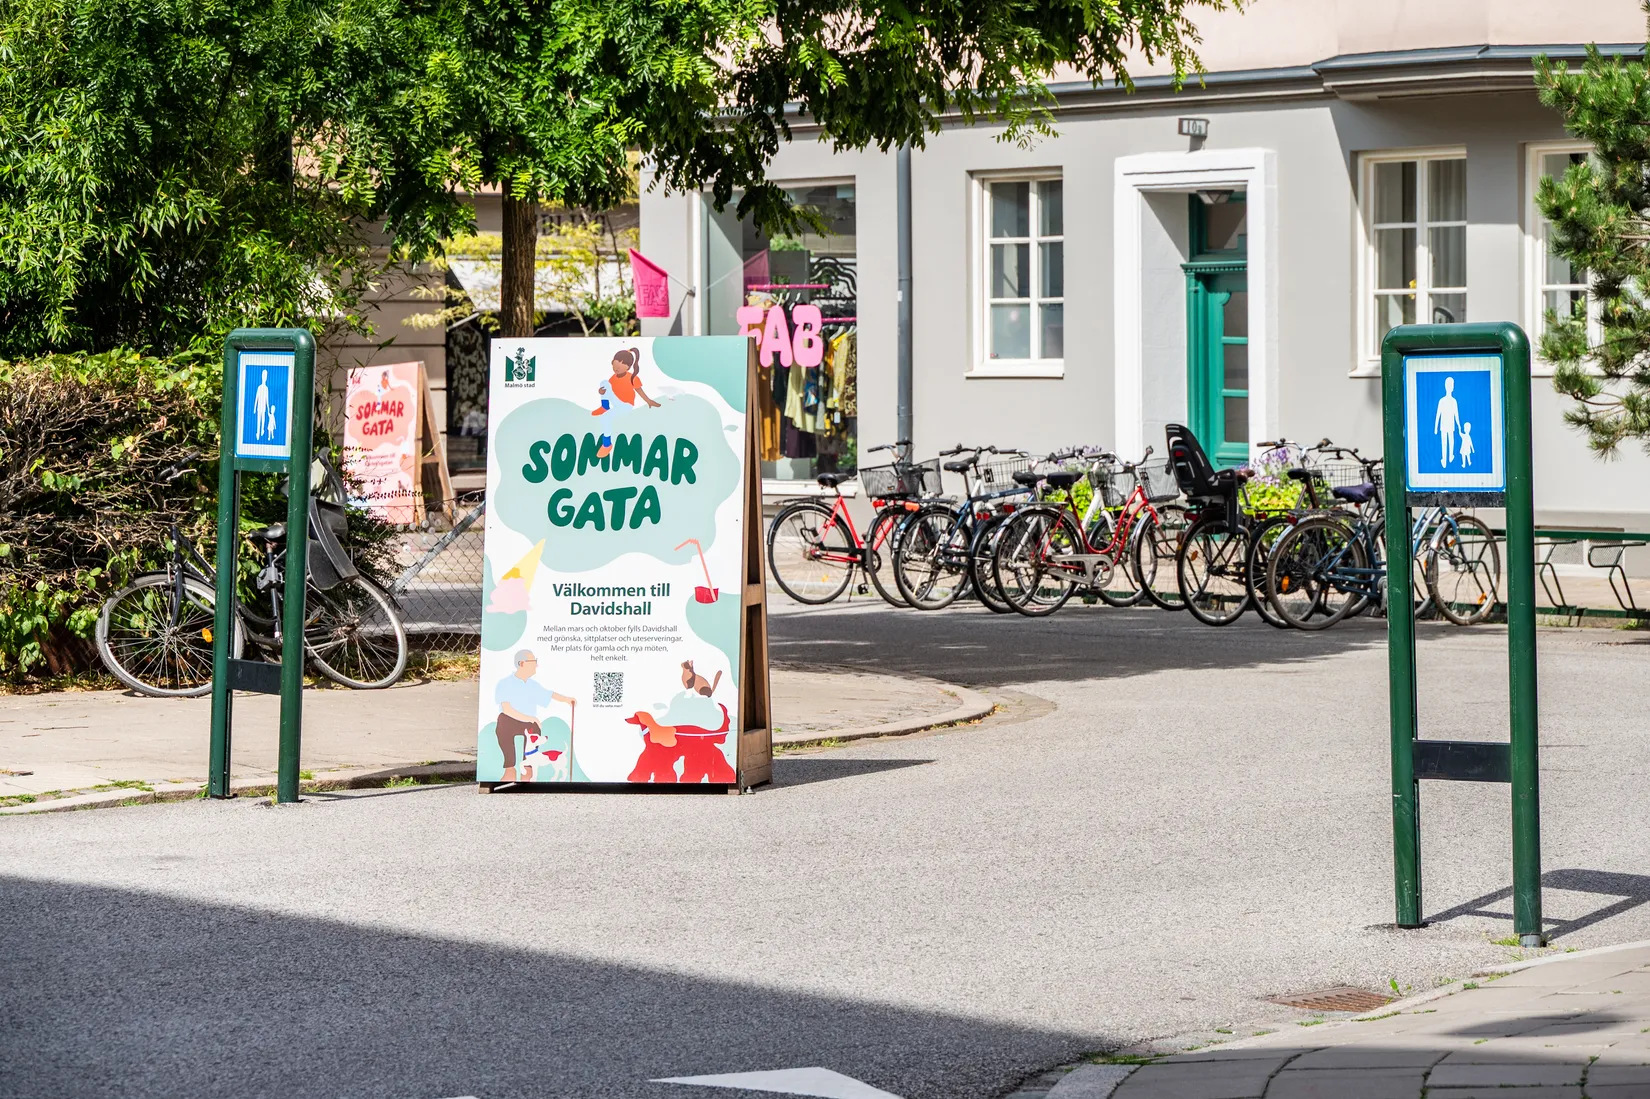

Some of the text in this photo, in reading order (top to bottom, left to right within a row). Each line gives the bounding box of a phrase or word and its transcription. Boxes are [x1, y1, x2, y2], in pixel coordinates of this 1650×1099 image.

[736, 304, 824, 368] FAB
[362, 419, 394, 436] GATA
[522, 432, 698, 485] SOMMAR
[547, 485, 661, 531] GATA
[552, 582, 671, 597] Välkommen till
[570, 601, 651, 616] Davidshall
[628, 625, 641, 633] fylls
[554, 635, 582, 643] grönska,
[584, 635, 617, 643] sittplatser
[633, 635, 683, 643] uteserveringar.
[566, 645, 582, 653] plats
[594, 645, 615, 653] gamla
